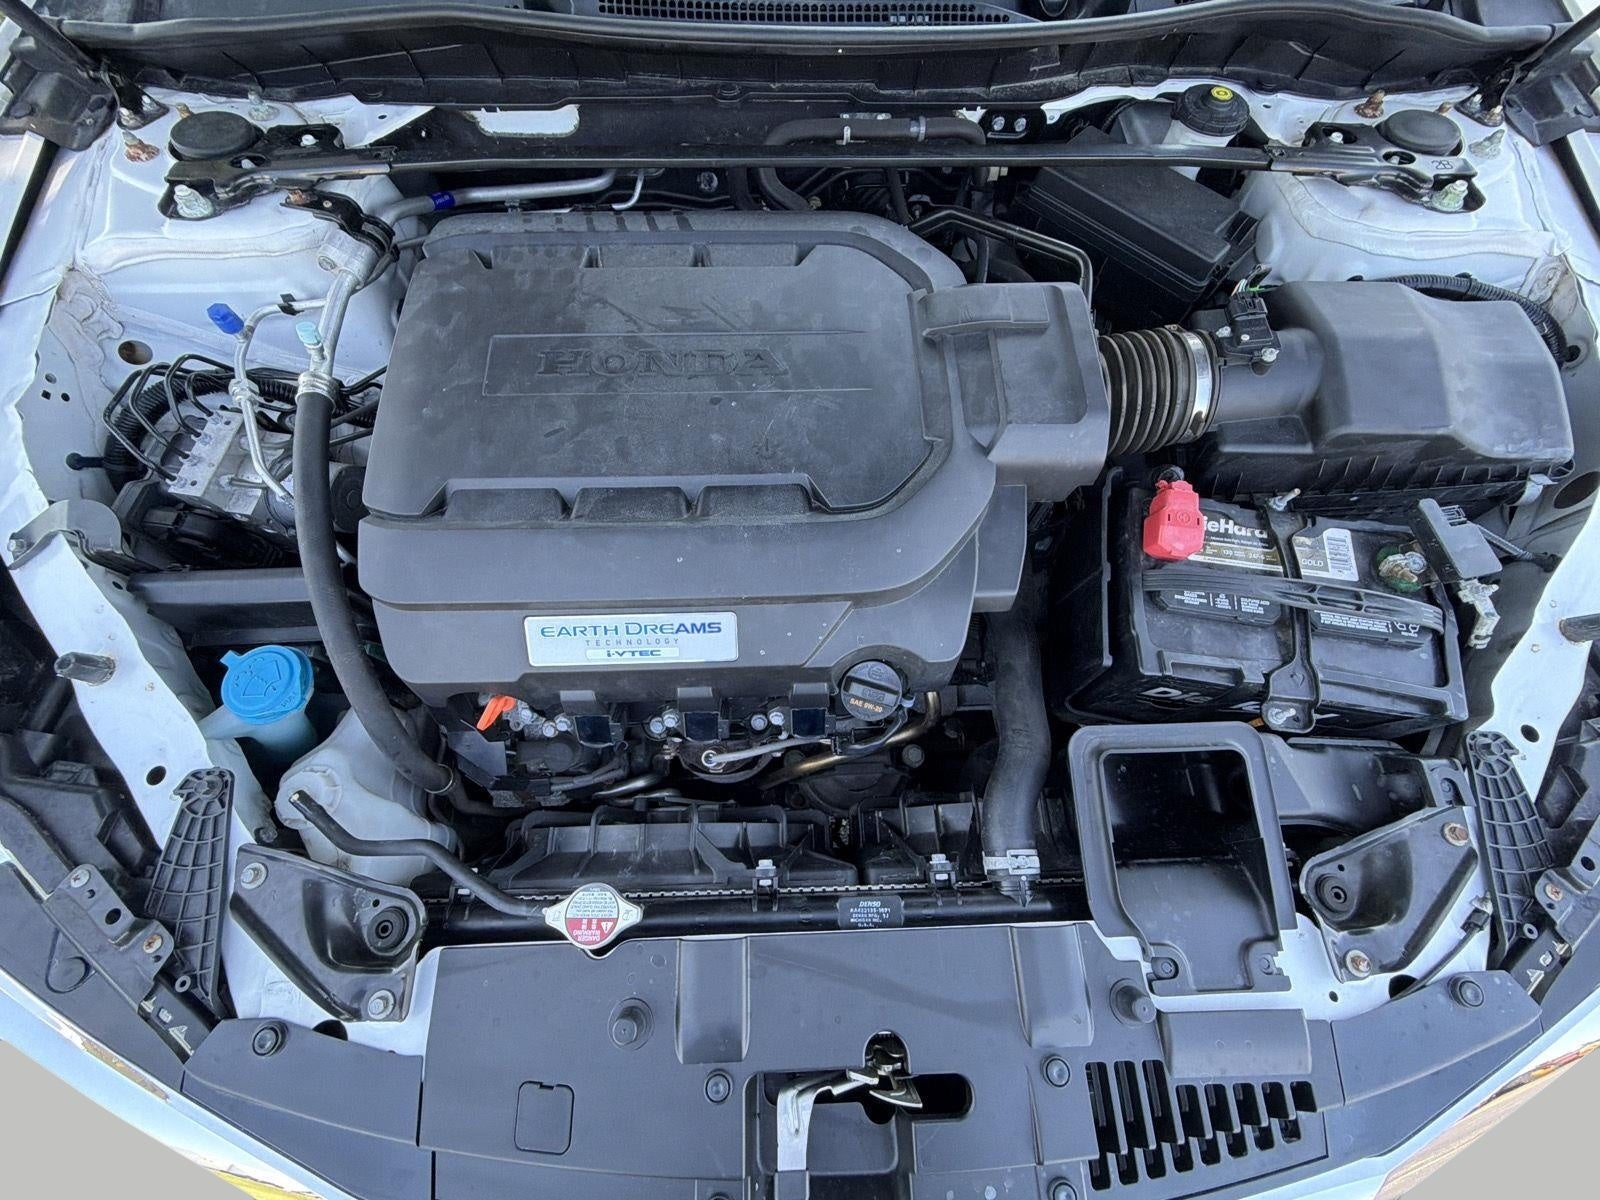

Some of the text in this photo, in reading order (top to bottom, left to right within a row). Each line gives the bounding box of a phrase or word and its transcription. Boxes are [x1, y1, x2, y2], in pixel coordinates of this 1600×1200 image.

[537, 348, 790, 376] HONDA
[1302, 559, 1324, 567] GOLD
[541, 622, 722, 637] EARTH DREAMS
[585, 639, 680, 647] TECHNOLOGY
[606, 649, 662, 658] i-VTEC
[850, 697, 863, 706] SAE
